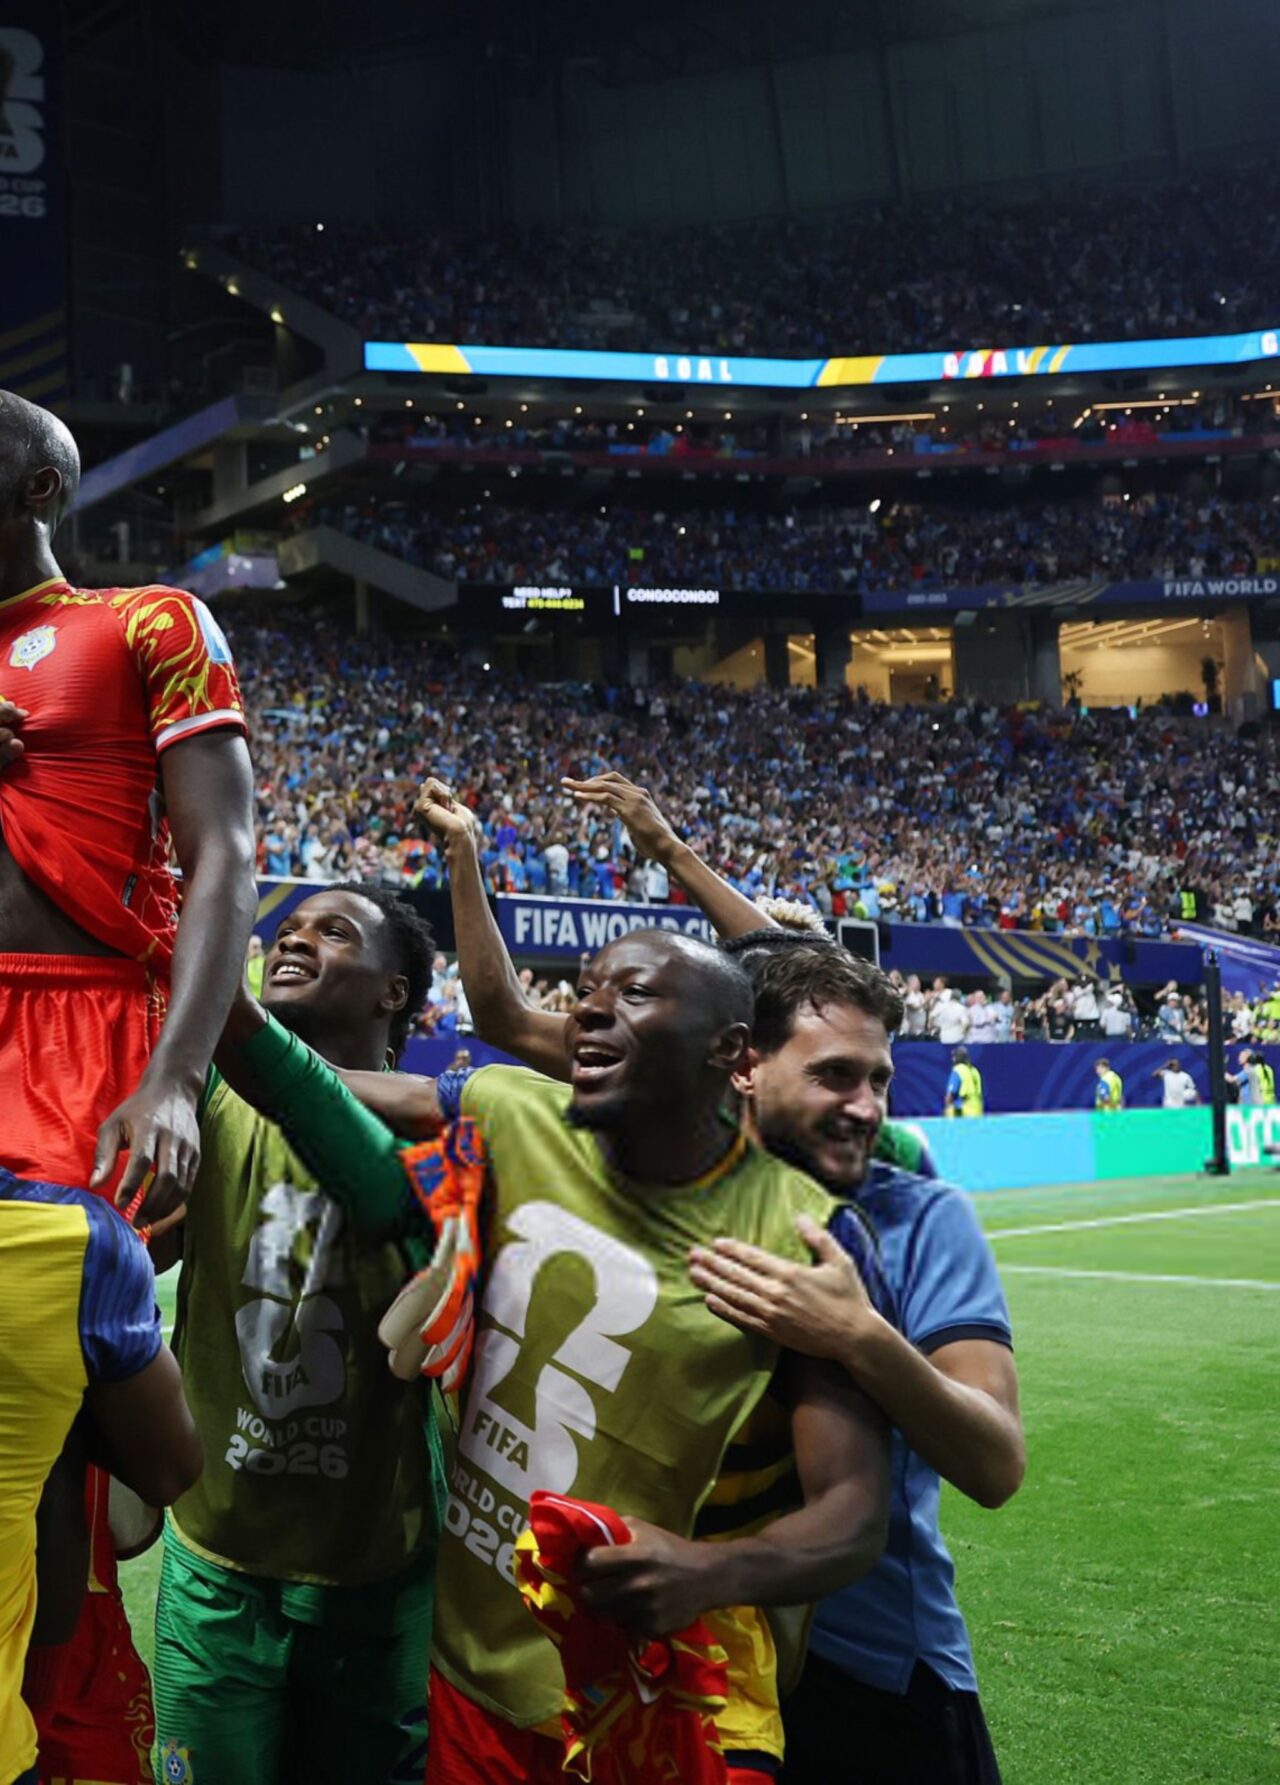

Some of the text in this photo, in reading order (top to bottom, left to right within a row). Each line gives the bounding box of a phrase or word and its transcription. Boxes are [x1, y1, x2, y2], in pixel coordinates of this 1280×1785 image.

[11, 178, 46, 194] CUP
[654, 356, 732, 382] GOAL
[1164, 579, 1277, 597] FIFA WORLD
[514, 907, 579, 947] FIFA
[261, 1364, 310, 1398] FIFA
[237, 1407, 347, 1448] WORLD CUP
[472, 1410, 529, 1473] FIFA
[224, 1434, 349, 1479] 2026
[497, 1504, 532, 1537] CU
[444, 1493, 519, 1588] 026
